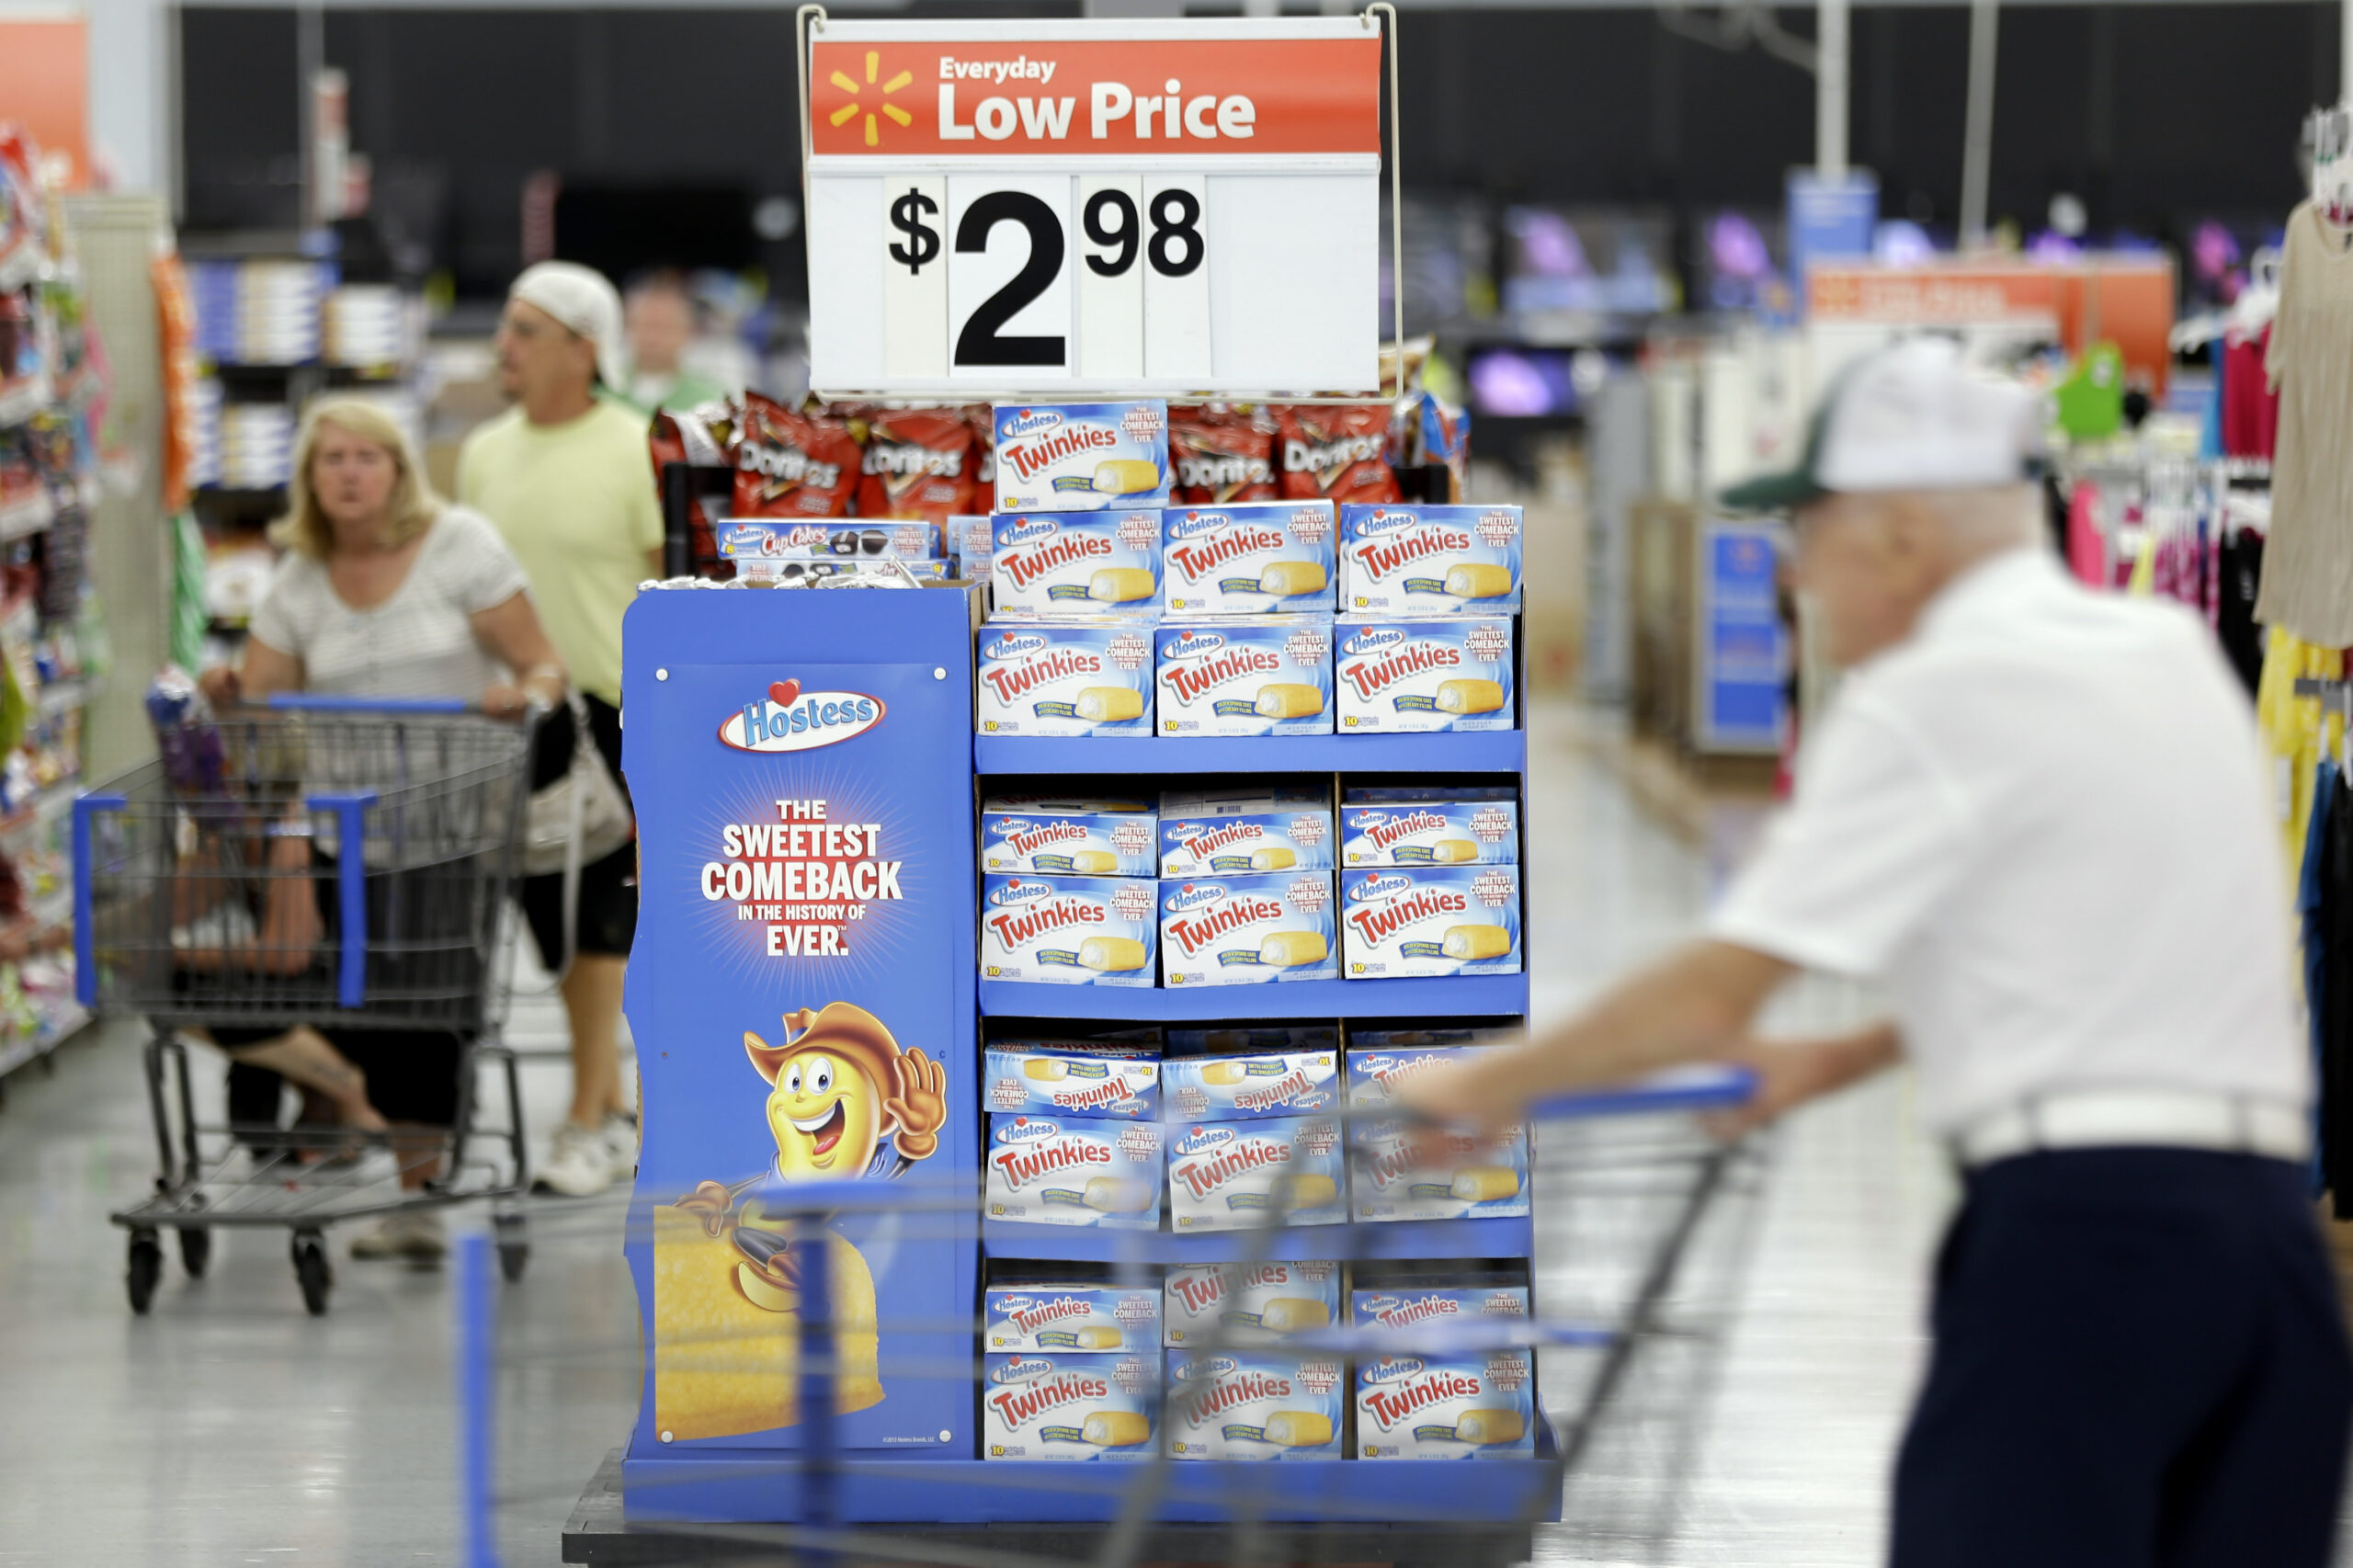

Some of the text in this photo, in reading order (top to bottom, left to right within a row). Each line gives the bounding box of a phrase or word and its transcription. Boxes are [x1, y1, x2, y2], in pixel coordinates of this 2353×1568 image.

[938, 56, 1056, 85] Everyday
[938, 78, 1256, 141] Low Price
[1124, 412, 1159, 421] SWEETEST
[1011, 414, 1057, 436] Hostess
[1120, 420, 1164, 430] COMEBACK
[1006, 426, 1116, 477] Twinkies
[1005, 497, 1017, 506] 10
[1120, 520, 1154, 528] SWEETEST
[1291, 514, 1325, 523] SWEETEST
[1479, 517, 1514, 525] SWEETEST
[1177, 517, 1224, 538] Hostess
[1287, 521, 1331, 532] COMEBACK
[1364, 515, 1411, 535] Hostess
[1473, 525, 1518, 534] COMEBACK
[1006, 523, 1052, 544] Hostess
[1115, 528, 1159, 539] COMEBACK
[725, 544, 734, 554] 8
[1172, 528, 1283, 579] Twinkies
[1357, 528, 1469, 577] Twinkies
[1001, 534, 1111, 585] Twinkies
[1171, 598, 1184, 608] 10
[1355, 597, 1367, 606] 10
[1288, 635, 1324, 643] SWEETEST
[1468, 631, 1504, 639] SWEETEST
[994, 637, 1041, 658] Hostess
[1109, 639, 1145, 647] SWEETEST
[1172, 636, 1220, 657] Hostess
[1283, 643, 1328, 653] COMEBACK
[1351, 631, 1400, 653] Hostess
[1463, 639, 1508, 649] COMEBACK
[1105, 647, 1150, 657] COMEBACK
[987, 650, 1100, 700] Twinkies
[1165, 648, 1279, 700] Twinkies
[1346, 643, 1460, 696] Twinkies
[742, 698, 873, 746] Hostess
[984, 721, 997, 731] 10
[1165, 721, 1177, 730] 10
[1345, 716, 1358, 726] 10
[776, 800, 827, 820] THE
[1355, 814, 1384, 827] Hostess
[1472, 812, 1507, 822] SWEETEST
[996, 823, 1026, 834] Hostess
[1291, 820, 1322, 828] SWEETEST
[1468, 821, 1512, 831] COMEBACK
[1114, 826, 1149, 835] SWEETEST
[1172, 826, 1201, 840] Hostess
[1288, 827, 1326, 836] COMEBACK
[1367, 813, 1445, 848] Twinkies
[722, 824, 881, 858] SWEETEST
[1007, 823, 1086, 855] Twinkies
[1109, 834, 1153, 844] COMEBACK
[1184, 824, 1262, 859] Twinkies
[989, 858, 1000, 867] 10
[1348, 853, 1359, 861] 10
[1166, 865, 1178, 873] 10
[701, 861, 904, 901] COMEBACK
[1474, 876, 1510, 884] SWEETEST
[1289, 881, 1324, 892] SWEETEST
[1358, 878, 1405, 900] Hostess
[1470, 883, 1515, 894] COMEBACK
[998, 885, 1047, 904] Hostess
[1114, 890, 1150, 899] SWEETEST
[1173, 887, 1221, 911] Hostess
[1284, 889, 1330, 902] COMEBACK
[1109, 897, 1154, 909] COMEBACK
[738, 904, 867, 920] IN THE HISTORY OF
[1352, 889, 1466, 942] Twinkies
[991, 899, 1105, 947] Twinkies
[1169, 897, 1281, 952] Twinkies
[987, 966, 1000, 976] 10
[1351, 963, 1364, 972] 10
[1170, 973, 1183, 983] 10
[1053, 1078, 1133, 1111] Twinkies
[1234, 1072, 1313, 1110] Twinkies
[1006, 1123, 1053, 1142] Hostess
[1294, 1132, 1339, 1143] COMEBACK
[1116, 1138, 1161, 1151] COMEBACK
[1182, 1130, 1230, 1153] Hostess
[996, 1139, 1110, 1186] Twinkies
[1177, 1141, 1290, 1196] Twinkies
[991, 1204, 1005, 1214] 10
[1177, 1217, 1191, 1227] 10
[999, 1300, 1029, 1312] Hostess
[1367, 1298, 1397, 1311] Hostess
[1011, 1299, 1090, 1334] Twinkies
[1113, 1309, 1156, 1318] COMEBACK
[1379, 1297, 1458, 1330] Twinkies
[993, 1337, 1004, 1346] 10
[1171, 1331, 1184, 1341] 10
[1488, 1360, 1524, 1369] SWEETEST
[999, 1361, 1048, 1382] Hostess
[1295, 1370, 1340, 1382] COMEBACK
[1371, 1360, 1419, 1382] Hostess
[1483, 1369, 1529, 1379] COMEBACK
[993, 1374, 1107, 1426] Twinkies
[1176, 1373, 1290, 1423] Twinkies
[1365, 1373, 1479, 1426] Twinkies
[991, 1446, 1004, 1455] 10
[1174, 1443, 1186, 1452] 10
[1365, 1446, 1378, 1455] 10
